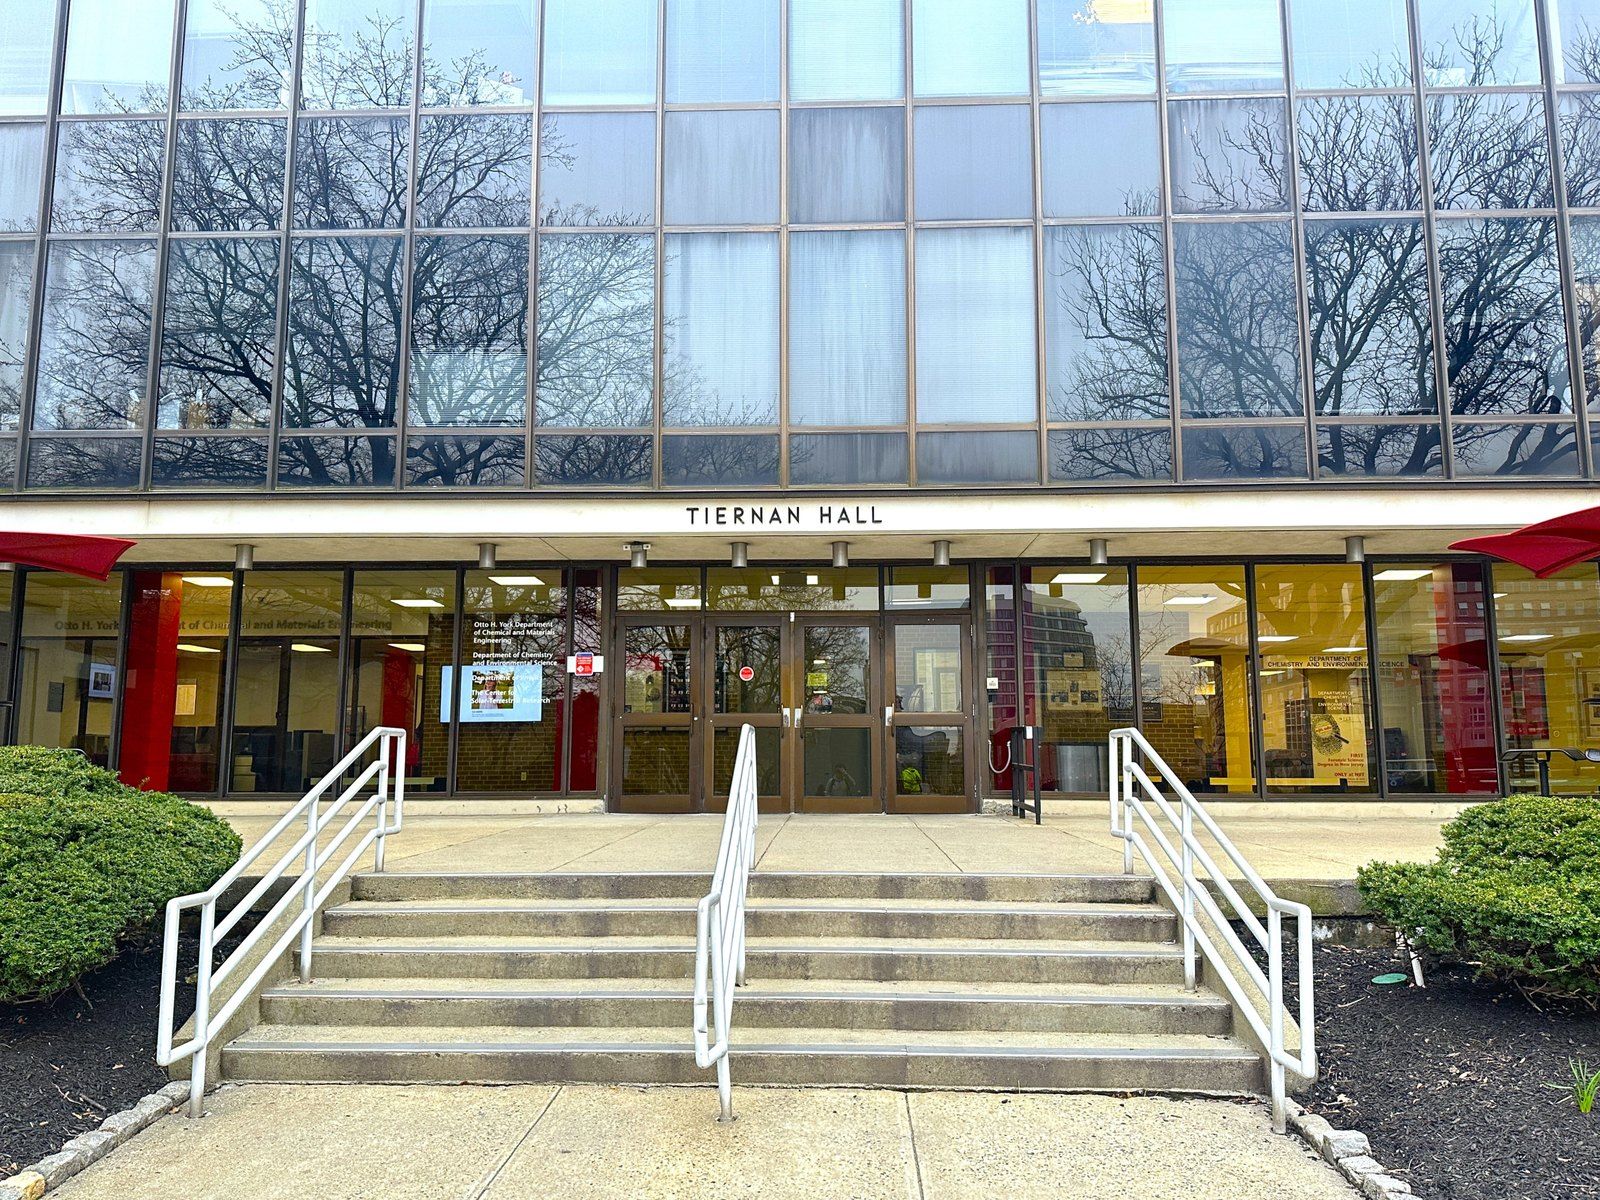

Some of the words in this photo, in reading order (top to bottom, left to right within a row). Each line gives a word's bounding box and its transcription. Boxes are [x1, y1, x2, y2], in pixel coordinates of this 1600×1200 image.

[686, 506, 800, 524] TIERNAN
[819, 506, 882, 524] HALL
[54, 620, 79, 630] Otto
[81, 620, 92, 630] H.
[96, 620, 119, 630] York
[189, 619, 201, 630] of
[202, 619, 250, 630] Chemal
[253, 619, 273, 630] and
[277, 619, 325, 630] Materials
[328, 619, 392, 632] Enneering
[515, 621, 553, 629] Department
[473, 637, 512, 645] Engineering
[472, 674, 511, 682] Department
